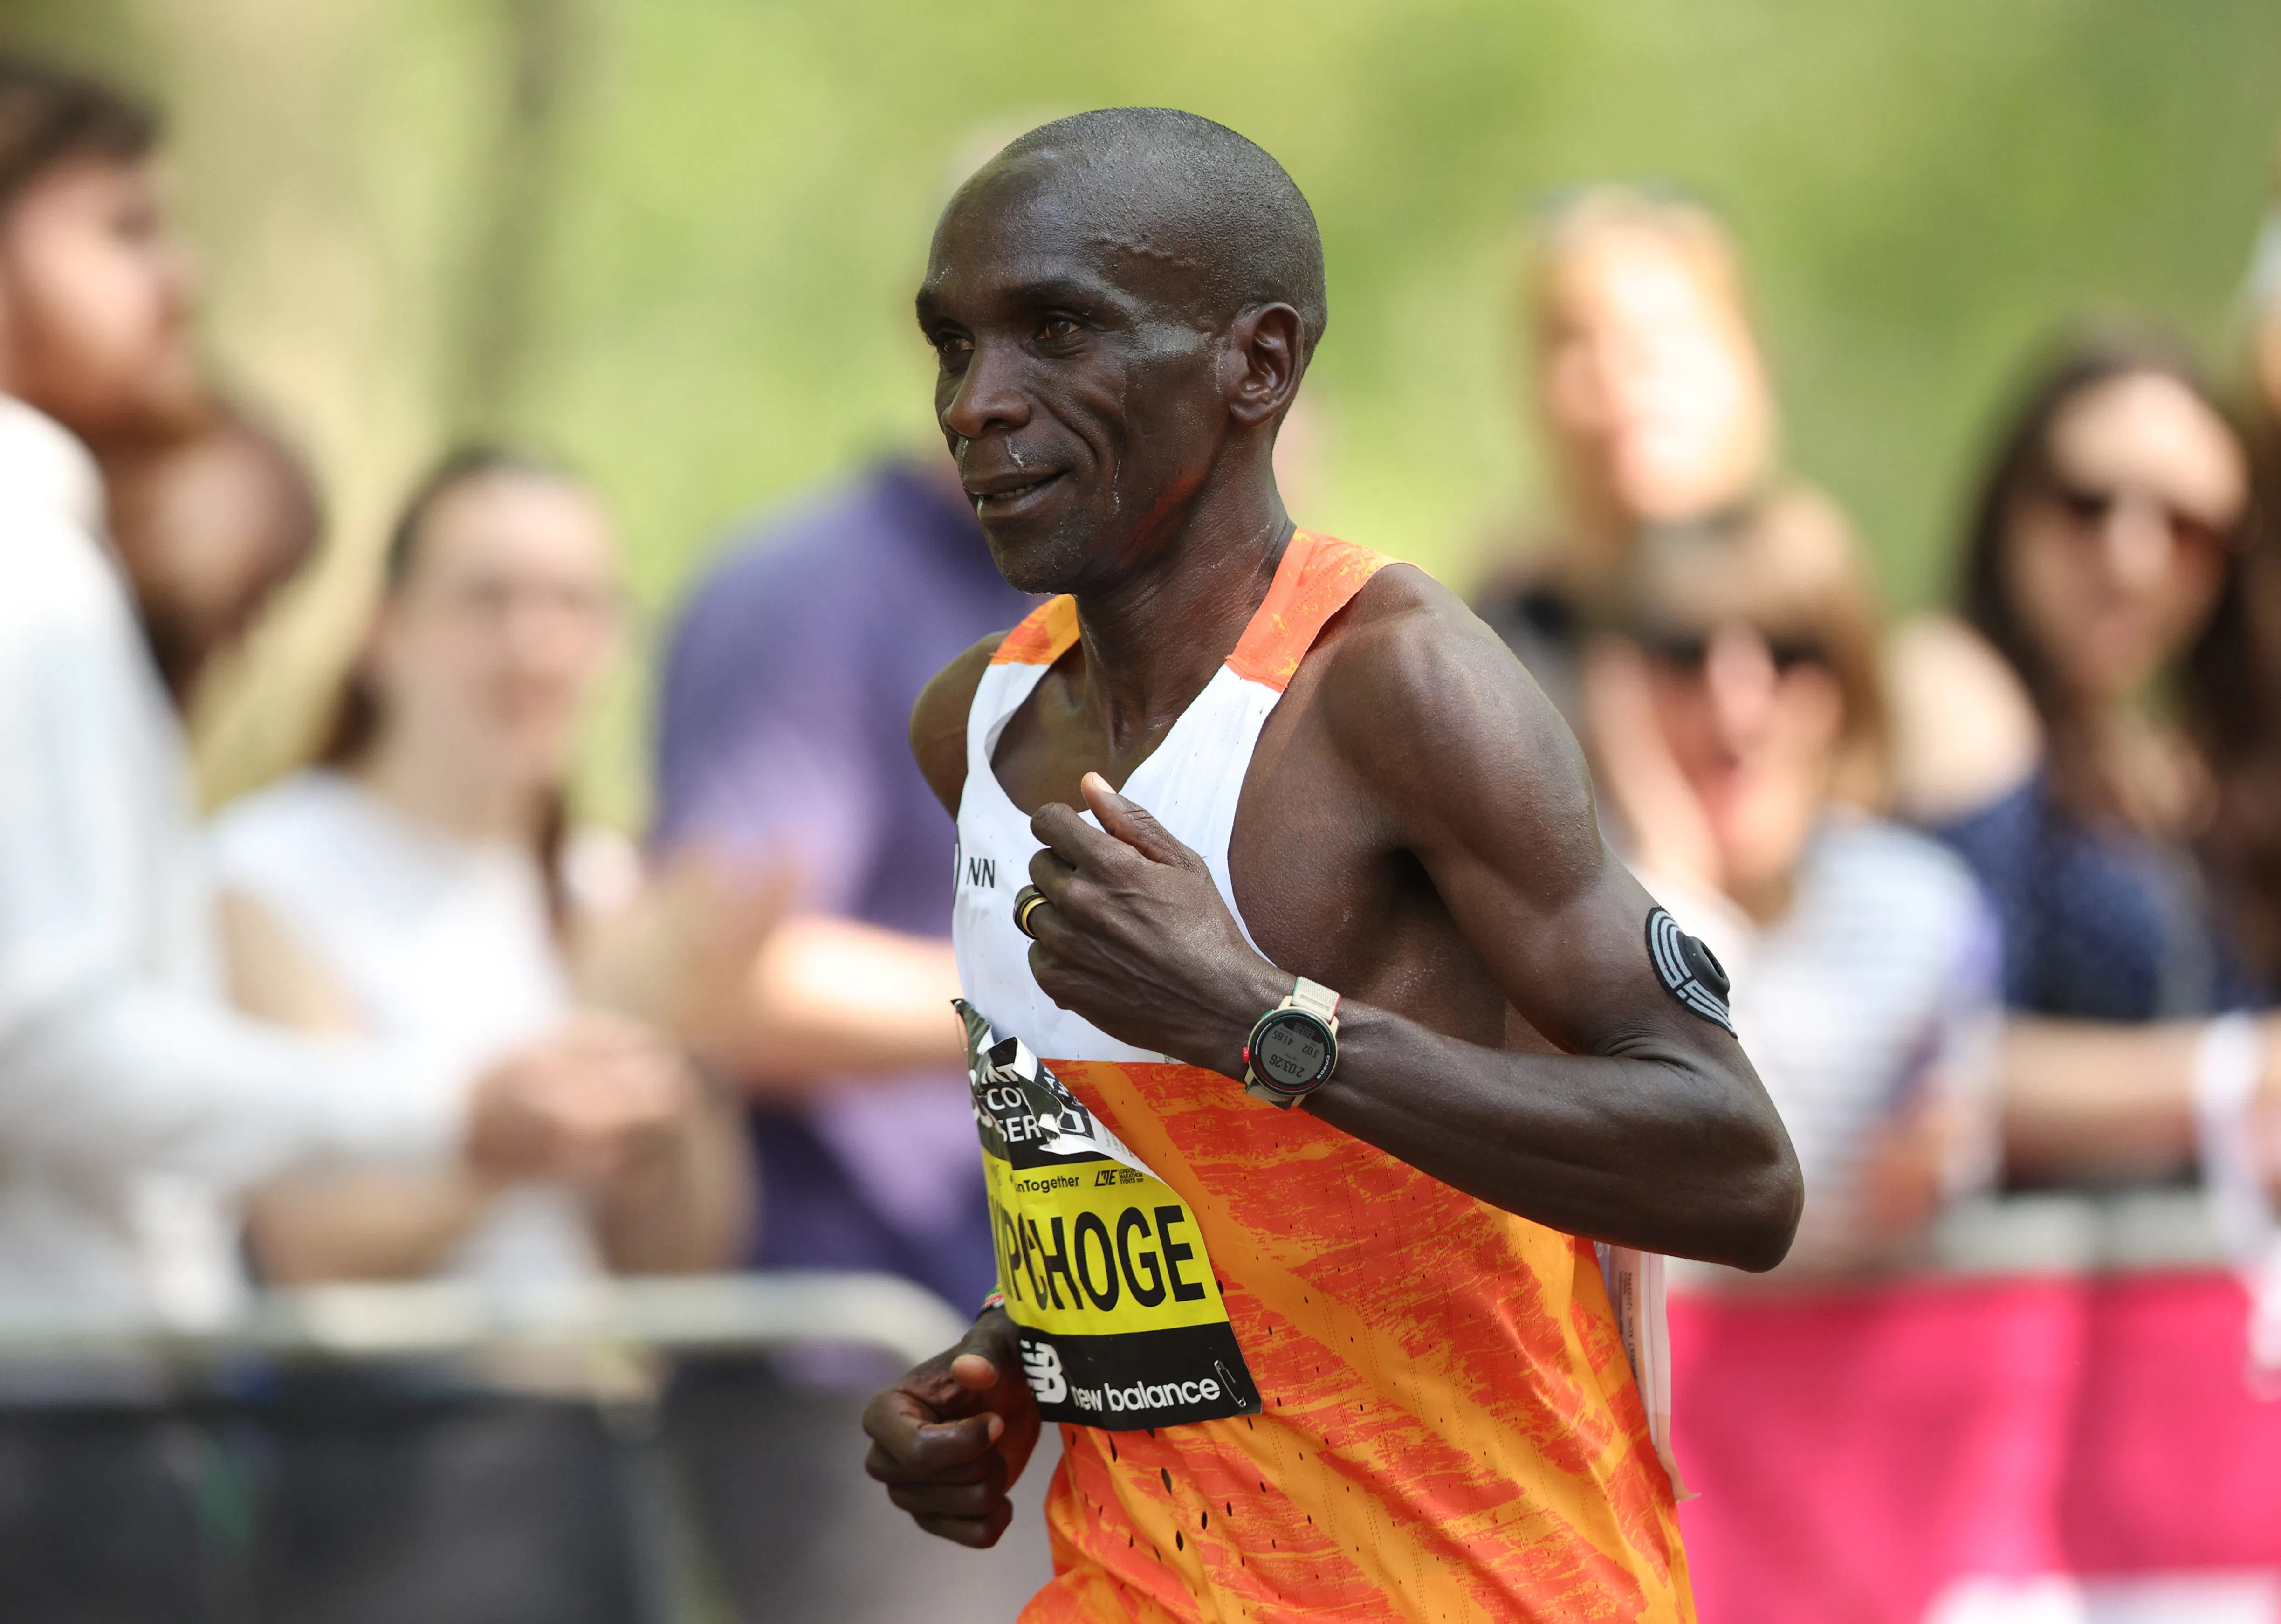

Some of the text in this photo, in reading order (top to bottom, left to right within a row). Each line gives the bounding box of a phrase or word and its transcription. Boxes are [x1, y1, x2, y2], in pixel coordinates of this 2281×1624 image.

[966, 856, 995, 888] NN
[1269, 1054, 1305, 1078] 2:03:26
[1317, 1055, 1330, 1080] COROS
[1070, 1378, 1221, 1412] new balance
